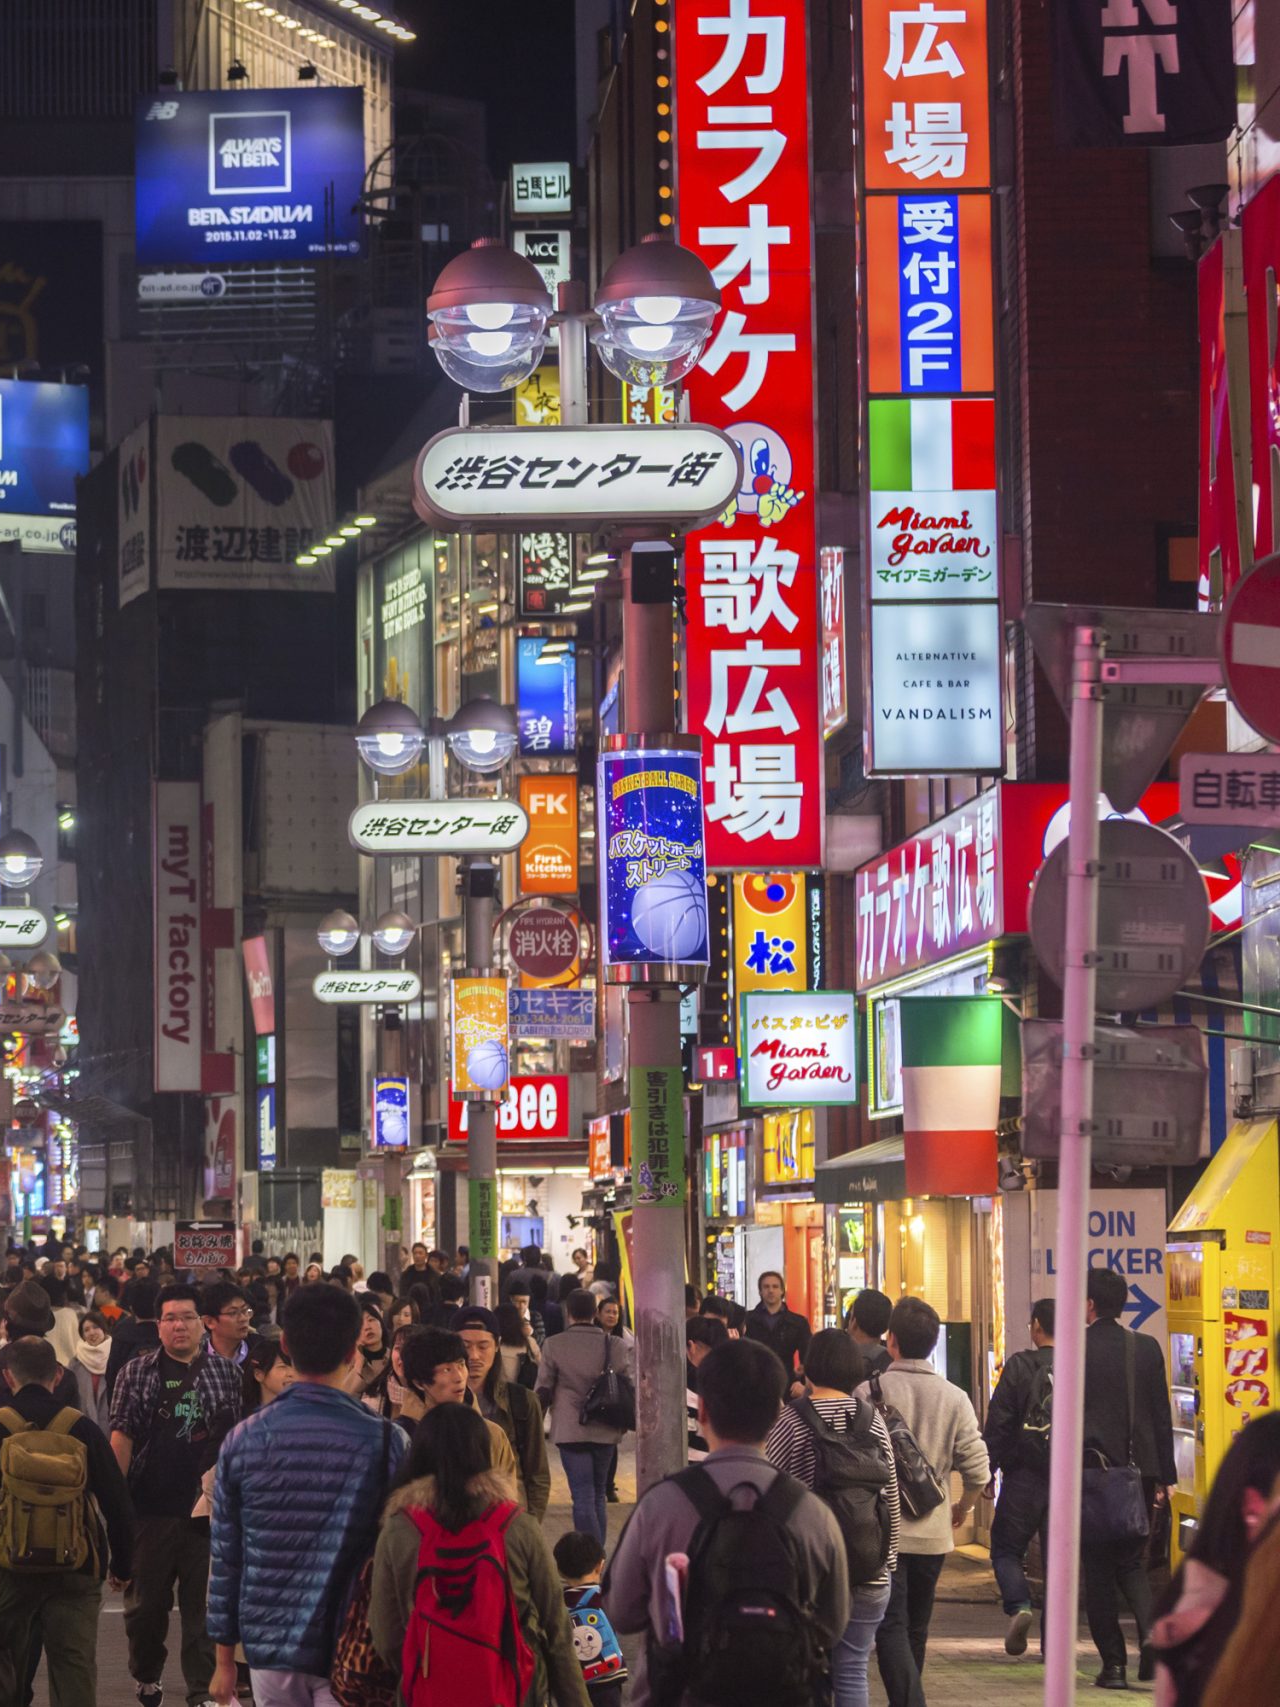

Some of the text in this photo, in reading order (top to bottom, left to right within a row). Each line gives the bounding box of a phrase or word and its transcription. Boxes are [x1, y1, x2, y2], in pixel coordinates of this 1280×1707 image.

[883, 3, 969, 180] 広場
[220, 137, 282, 154] ALWAYS
[223, 152, 279, 168] IN BETA
[516, 175, 570, 200] 白馬ビル
[188, 204, 313, 226] BETA STADIUM
[696, 0, 797, 412] カラオケ
[526, 242, 560, 257] MCC
[435, 452, 723, 491] 渋谷センター街
[877, 506, 973, 532] Miami
[876, 567, 992, 584] マイアミガーデン
[896, 652, 977, 661] ALTERNATIVE
[700, 536, 804, 843] 歌広場
[903, 680, 971, 689] CAFE & BAR
[882, 707, 993, 721] VANDALISM
[1193, 769, 1280, 810] 自転車
[529, 793, 568, 815] FK
[360, 815, 519, 837] 渋谷センター街
[525, 862, 572, 873] Kitchen
[534, 854, 562, 865] First
[515, 930, 573, 957] 消火栓
[320, 983, 414, 994] 渋谷センター街
[752, 1012, 850, 1031] パスタとピザ
[750, 1039, 830, 1060] Miami
[1087, 1210, 1136, 1238] OIN
[1046, 1247, 1163, 1275] LCKER
